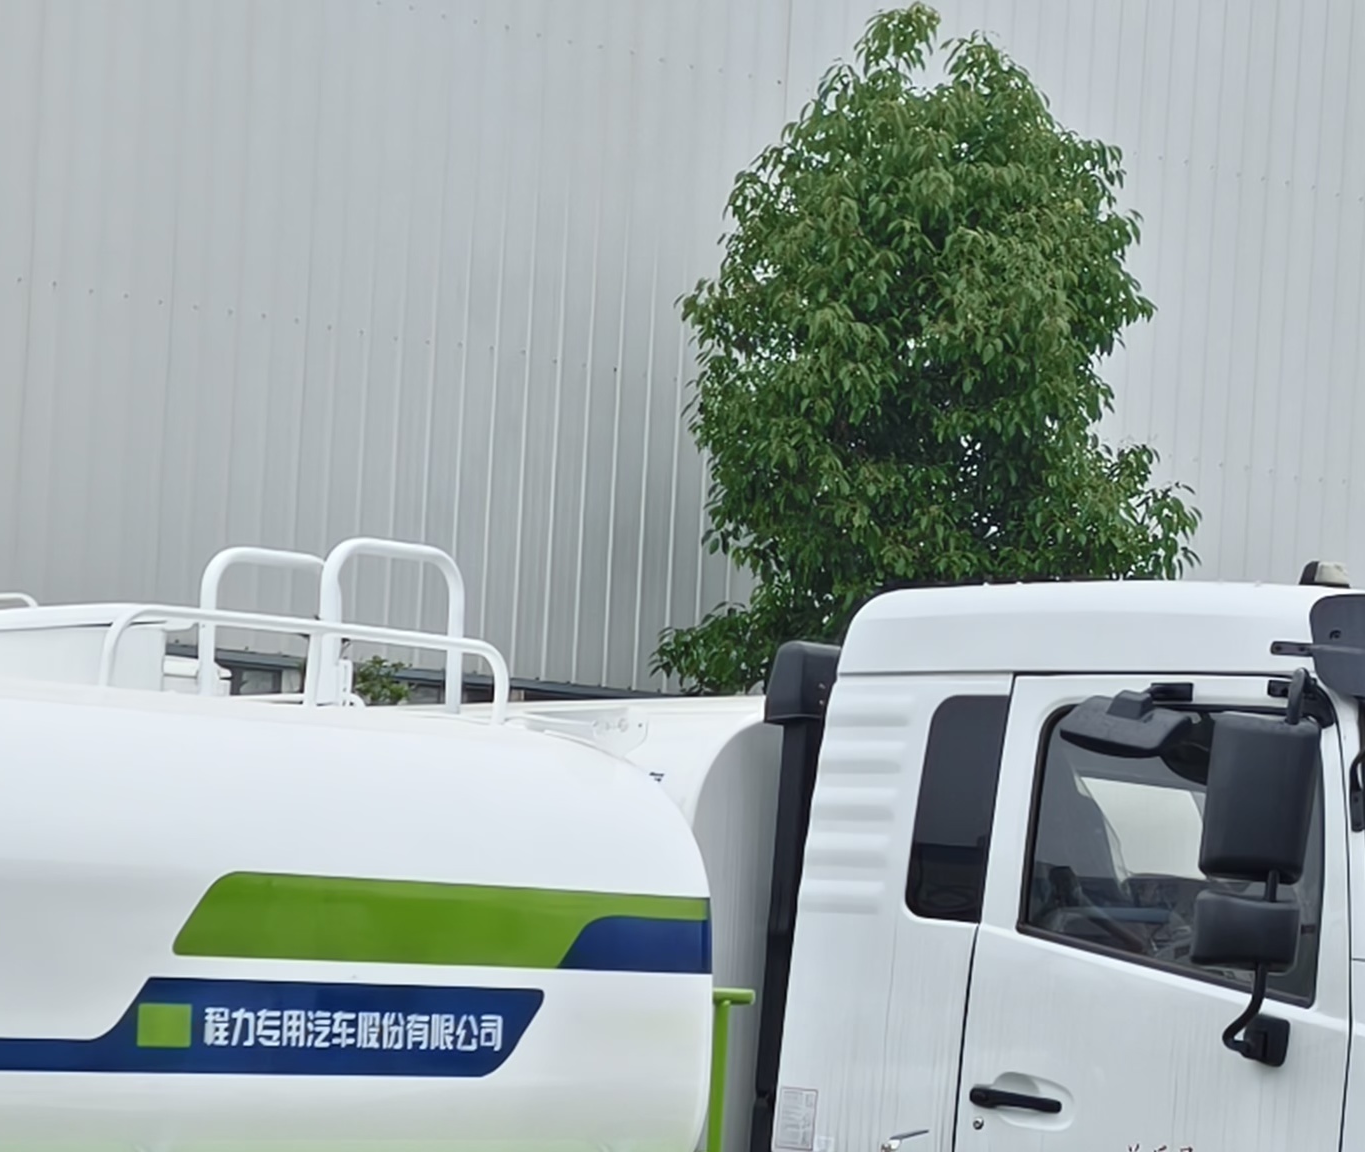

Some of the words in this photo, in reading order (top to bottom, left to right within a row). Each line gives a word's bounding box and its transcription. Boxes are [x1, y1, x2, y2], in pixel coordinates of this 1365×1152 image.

[202, 1005, 504, 1052] 程力专用汽车股份有限公司
